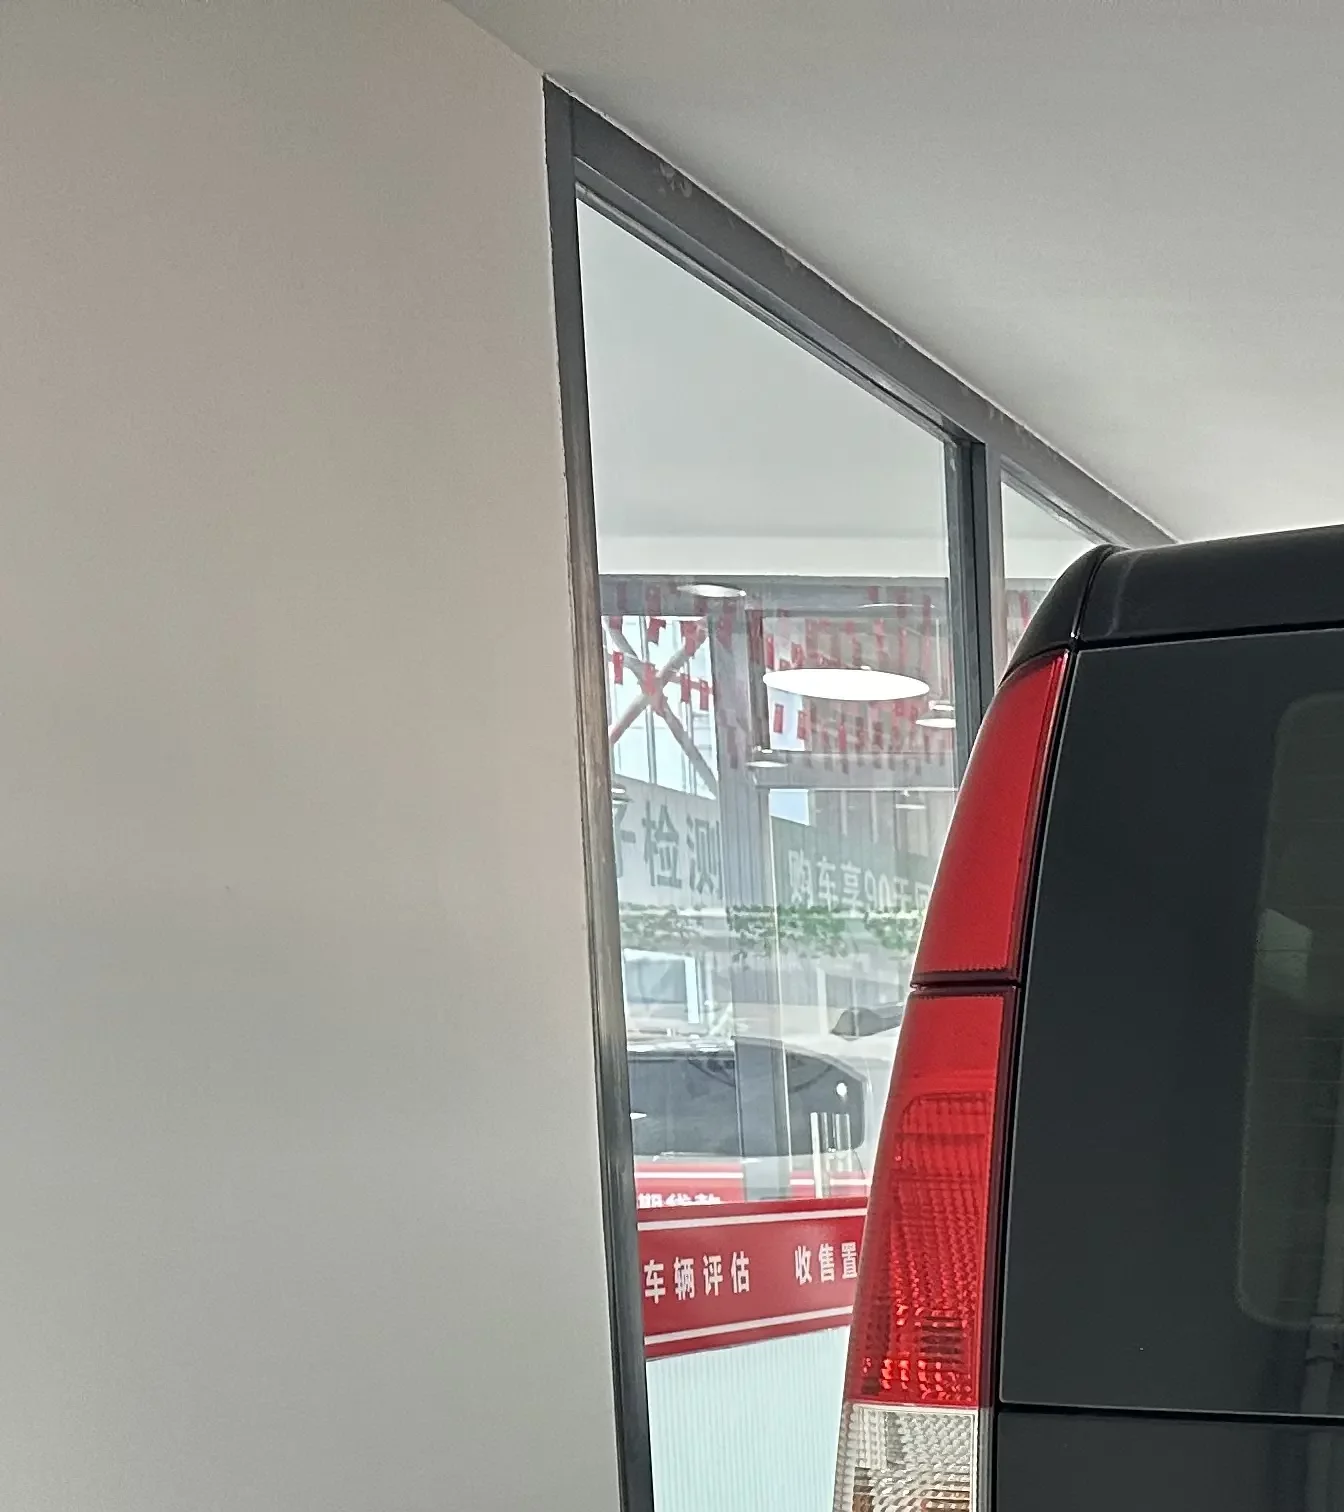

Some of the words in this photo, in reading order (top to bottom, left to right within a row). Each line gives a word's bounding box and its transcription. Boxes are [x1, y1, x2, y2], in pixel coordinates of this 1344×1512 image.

[643, 1251, 751, 1304] 车辆评估
[794, 1241, 858, 1286] 收售置
